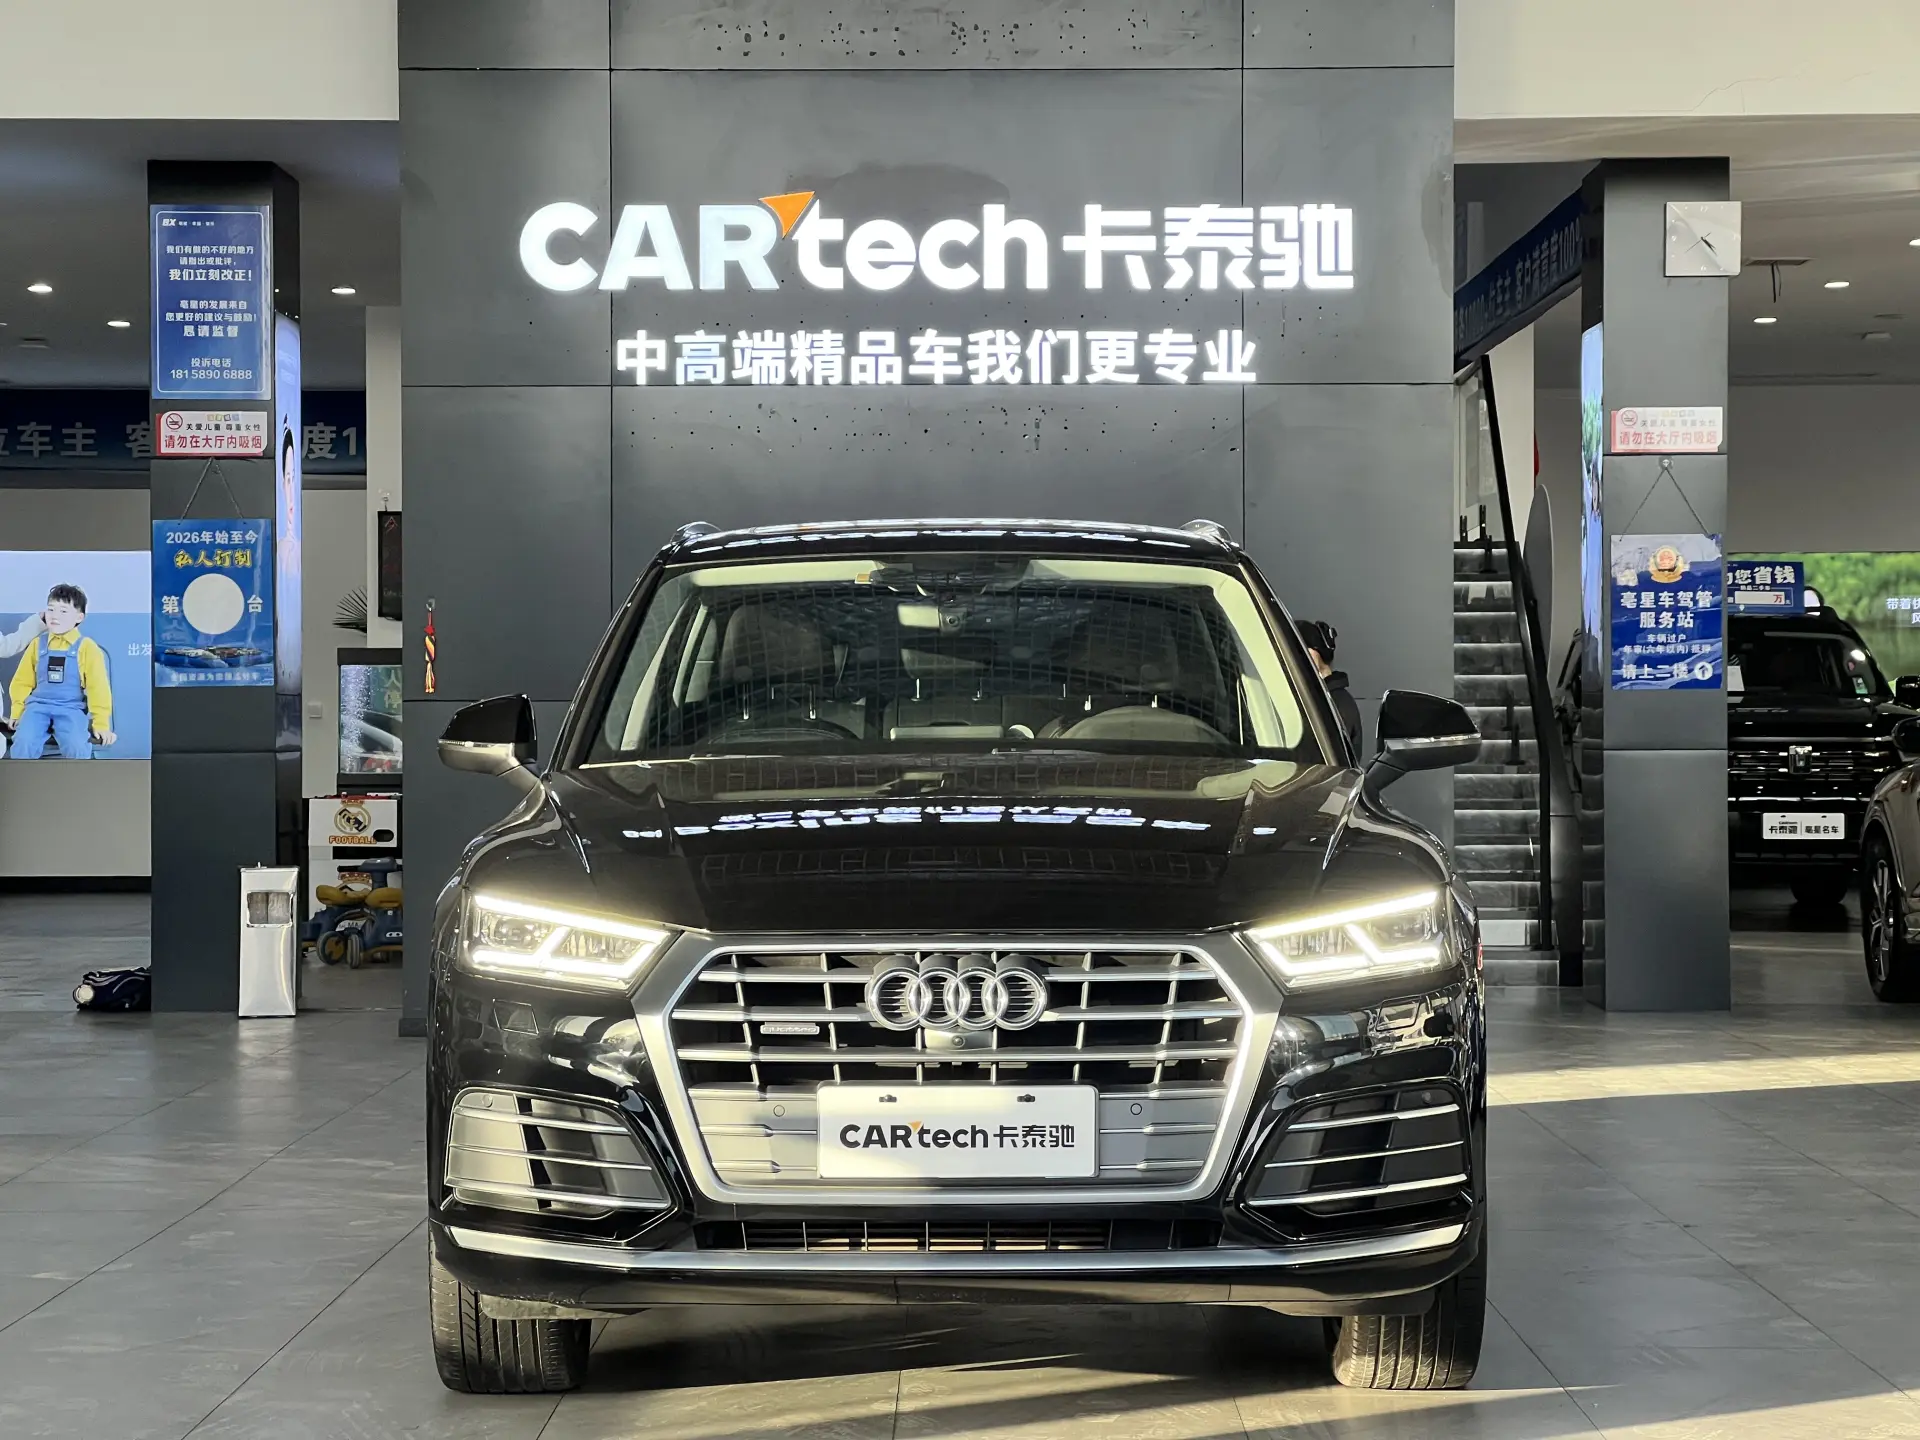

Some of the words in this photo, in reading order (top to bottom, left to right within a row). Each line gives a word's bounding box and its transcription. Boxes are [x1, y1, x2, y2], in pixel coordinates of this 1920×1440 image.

[519, 202, 1048, 292] CARtech
[1062, 203, 1354, 291] 卡泰驰
[191, 358, 232, 368] 投诉电话
[616, 329, 1256, 386] 中高端精品车我们更专业
[223, 370, 252, 379] 6888
[0, 422, 99, 459] 车主
[165, 434, 262, 448] 请勿在大厅内吸烟
[1620, 431, 1718, 445] 请勿在大厅内吸烟
[166, 529, 259, 545] 2026年始至今
[173, 549, 252, 568] 私人订制
[162, 595, 180, 614] 第
[246, 595, 265, 613] 台
[1773, 594, 1783, 603] 万
[1640, 612, 1694, 628] 服务站
[1648, 634, 1686, 643] 车辆过户
[1622, 663, 1688, 680] 请上二楼
[329, 836, 377, 844] FOOTBALL
[839, 1122, 989, 1149] CARtech
[993, 1124, 1076, 1148] 卡泰驰
